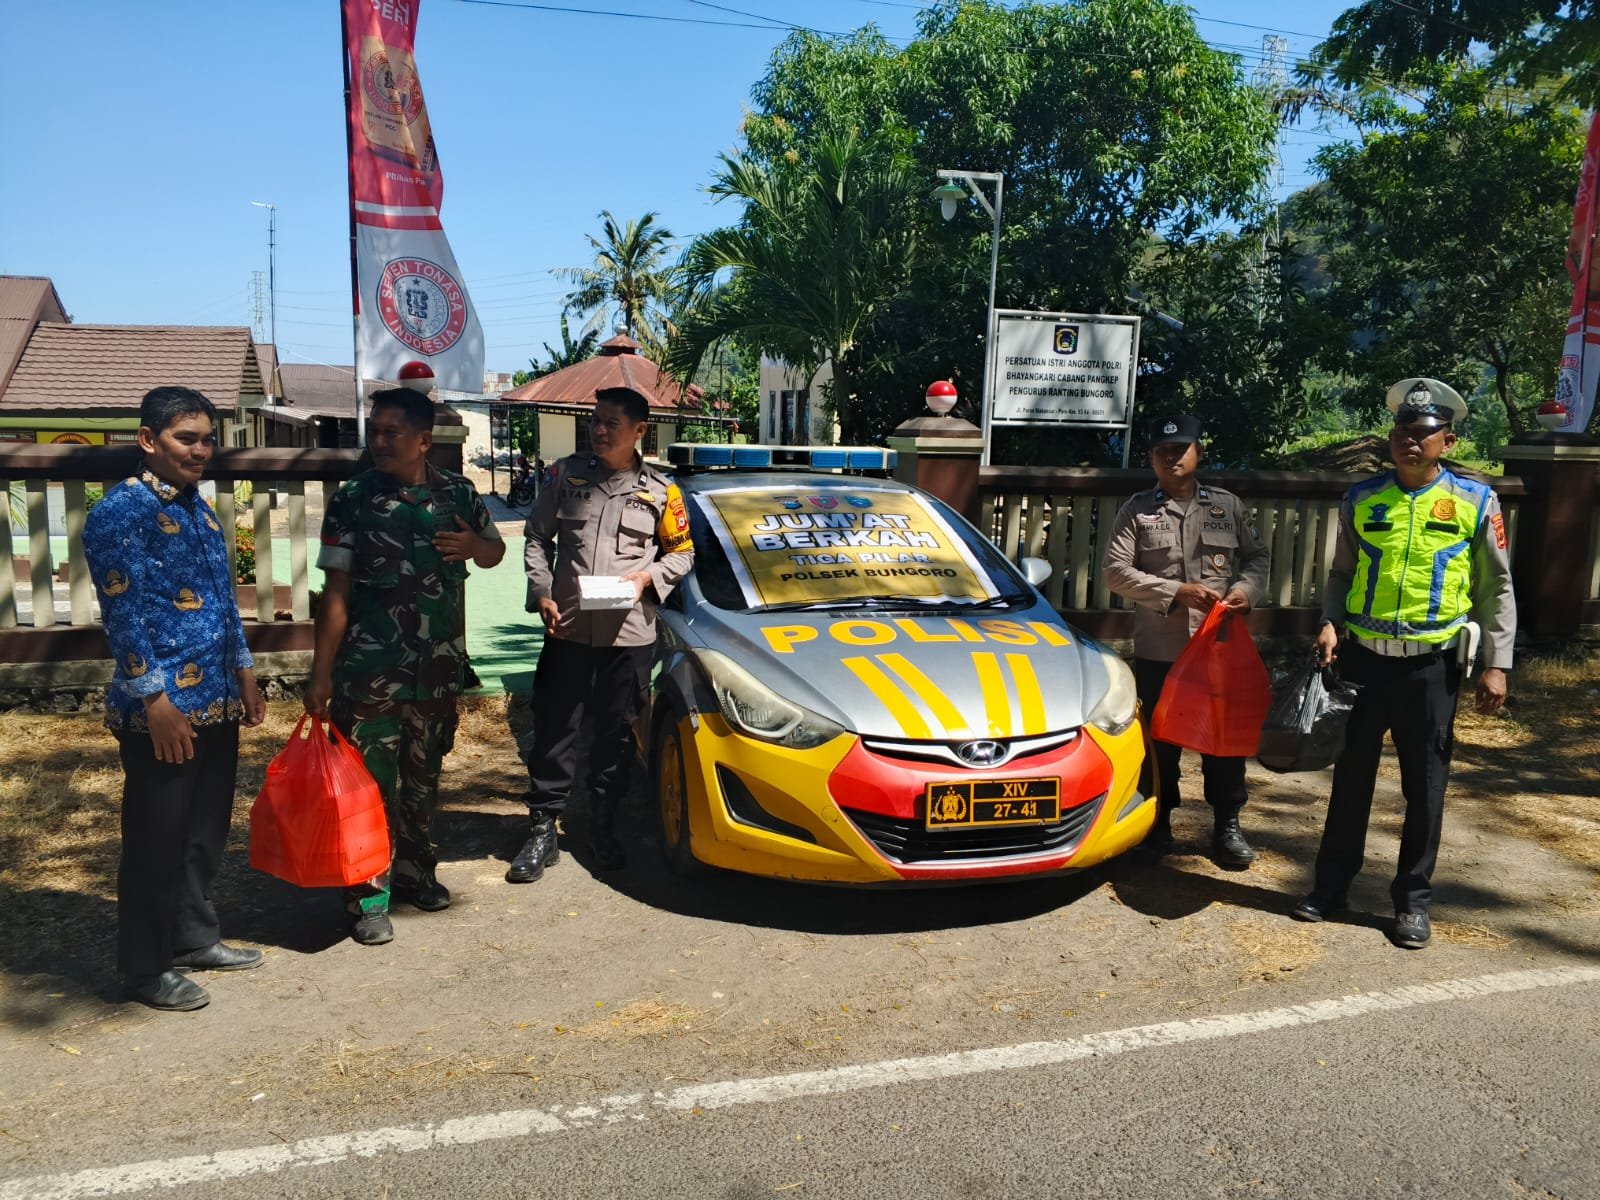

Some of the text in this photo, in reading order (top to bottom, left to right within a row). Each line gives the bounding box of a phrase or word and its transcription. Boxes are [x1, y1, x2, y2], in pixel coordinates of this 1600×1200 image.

[414, 261, 462, 312] TONASA
[1005, 356, 1121, 370] PERSATUAN ISTRI ANGGOTA POLRI
[1006, 371, 1118, 384] BHAYANGKARI CABANG PANGKEP
[1009, 387, 1114, 398] PENGURUS RANTING BUNGORO
[1203, 521, 1233, 530] POLRI
[751, 530, 941, 551] BERKAH
[789, 552, 933, 566] TIGA PILAR
[781, 567, 957, 582] POLSEK BUNGORO
[761, 619, 1071, 653] POLISI
[1003, 783, 1029, 797] XIV
